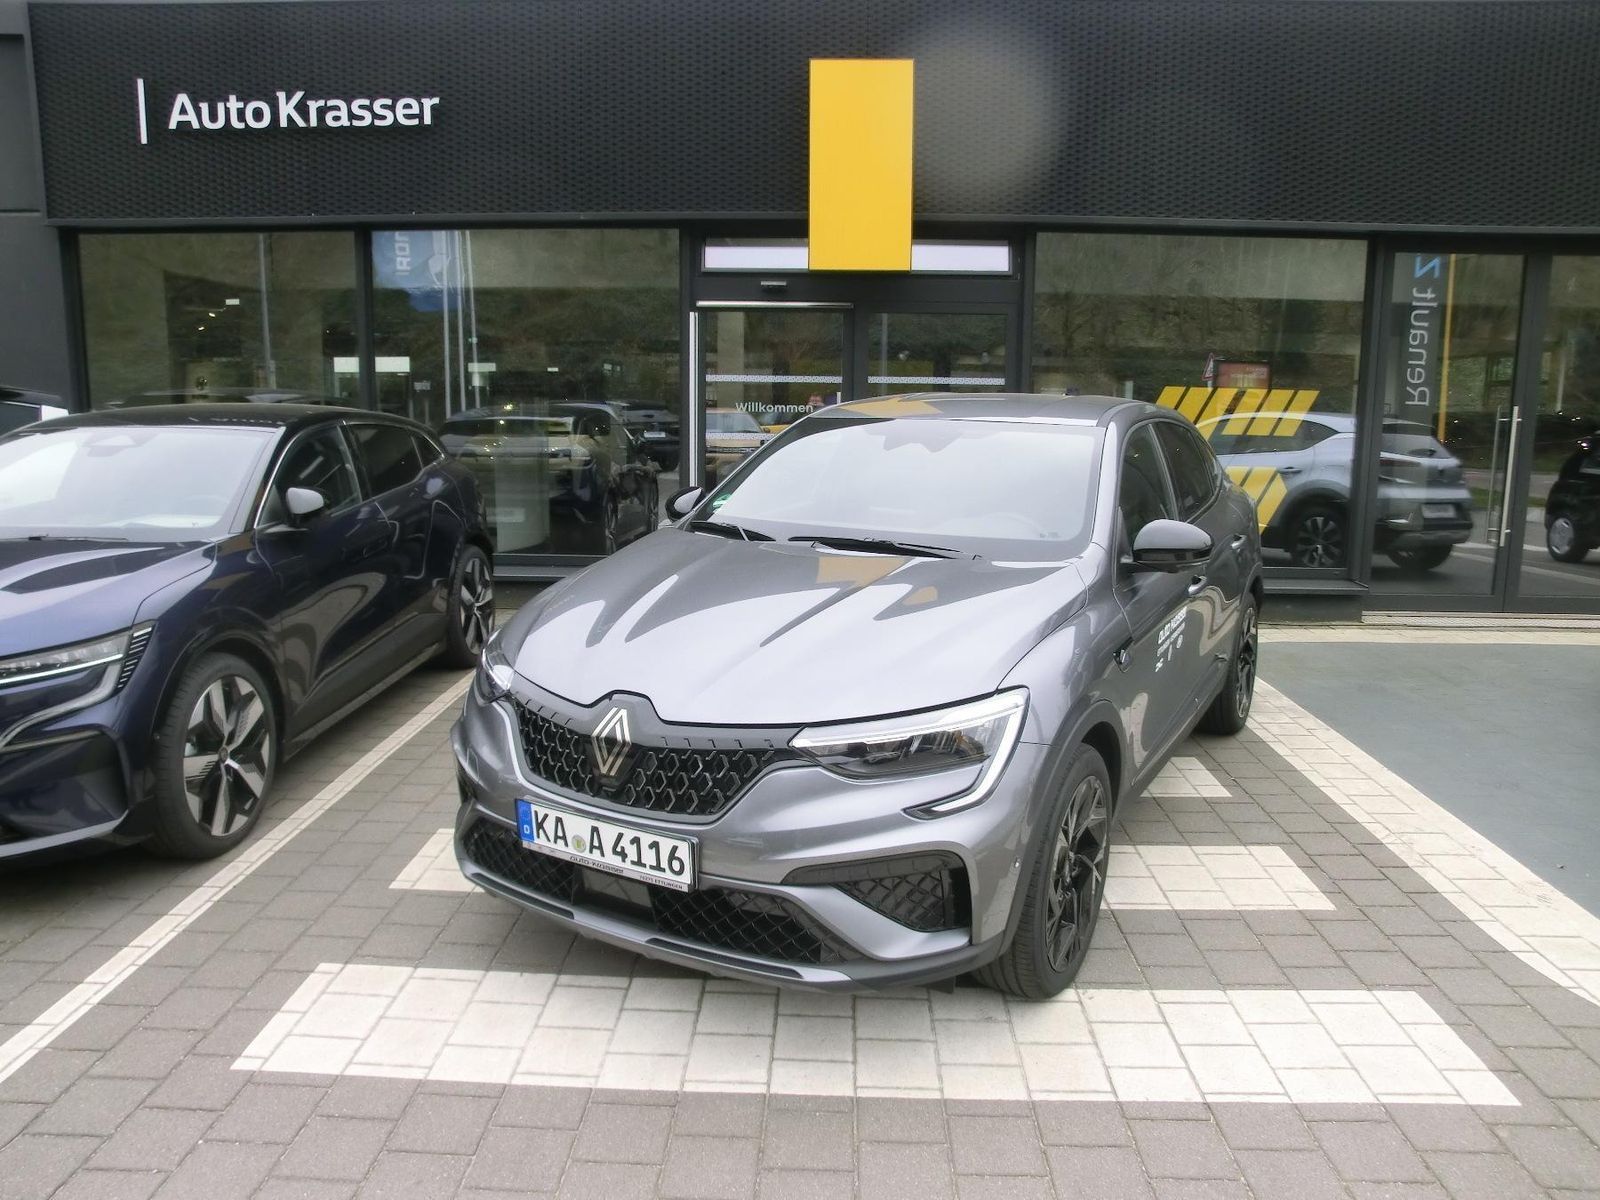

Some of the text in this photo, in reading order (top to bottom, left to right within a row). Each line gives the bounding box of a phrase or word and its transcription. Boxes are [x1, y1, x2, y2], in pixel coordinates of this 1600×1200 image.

[168, 91, 440, 130] Auto Krasser
[735, 402, 814, 413] Willkommen
[523, 810, 685, 876] D KA A 4116
